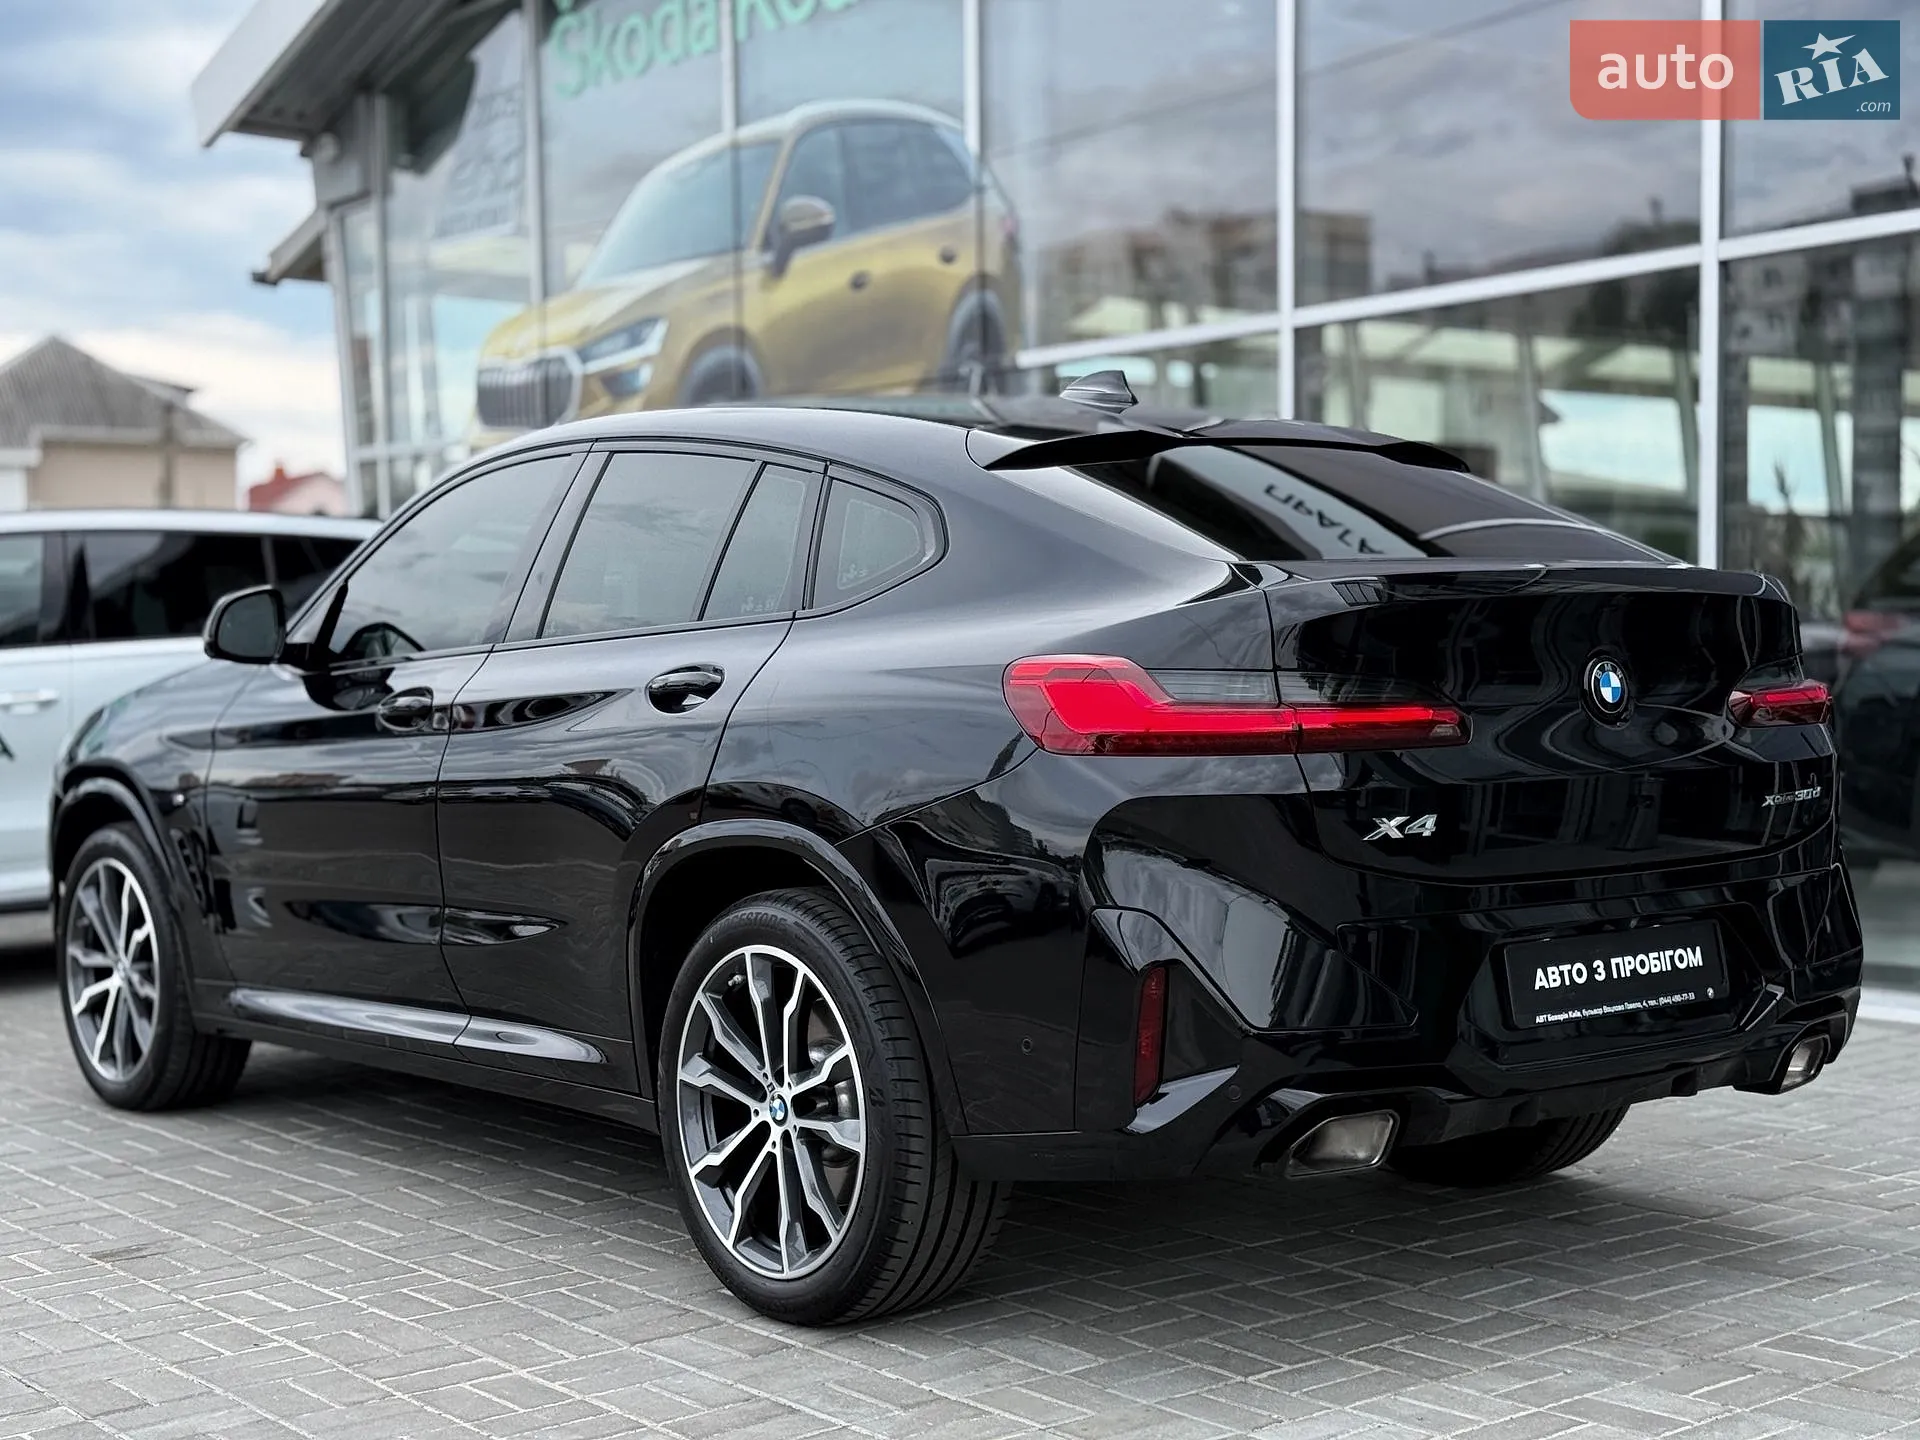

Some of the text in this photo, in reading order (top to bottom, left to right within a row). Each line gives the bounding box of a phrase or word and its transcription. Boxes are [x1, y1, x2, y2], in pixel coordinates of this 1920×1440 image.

[1594, 663, 1624, 680] BMW
[1362, 814, 1438, 841] X4
[1534, 962, 1588, 991] АВТО
[1610, 946, 1703, 979] ПРОБІГОМ
